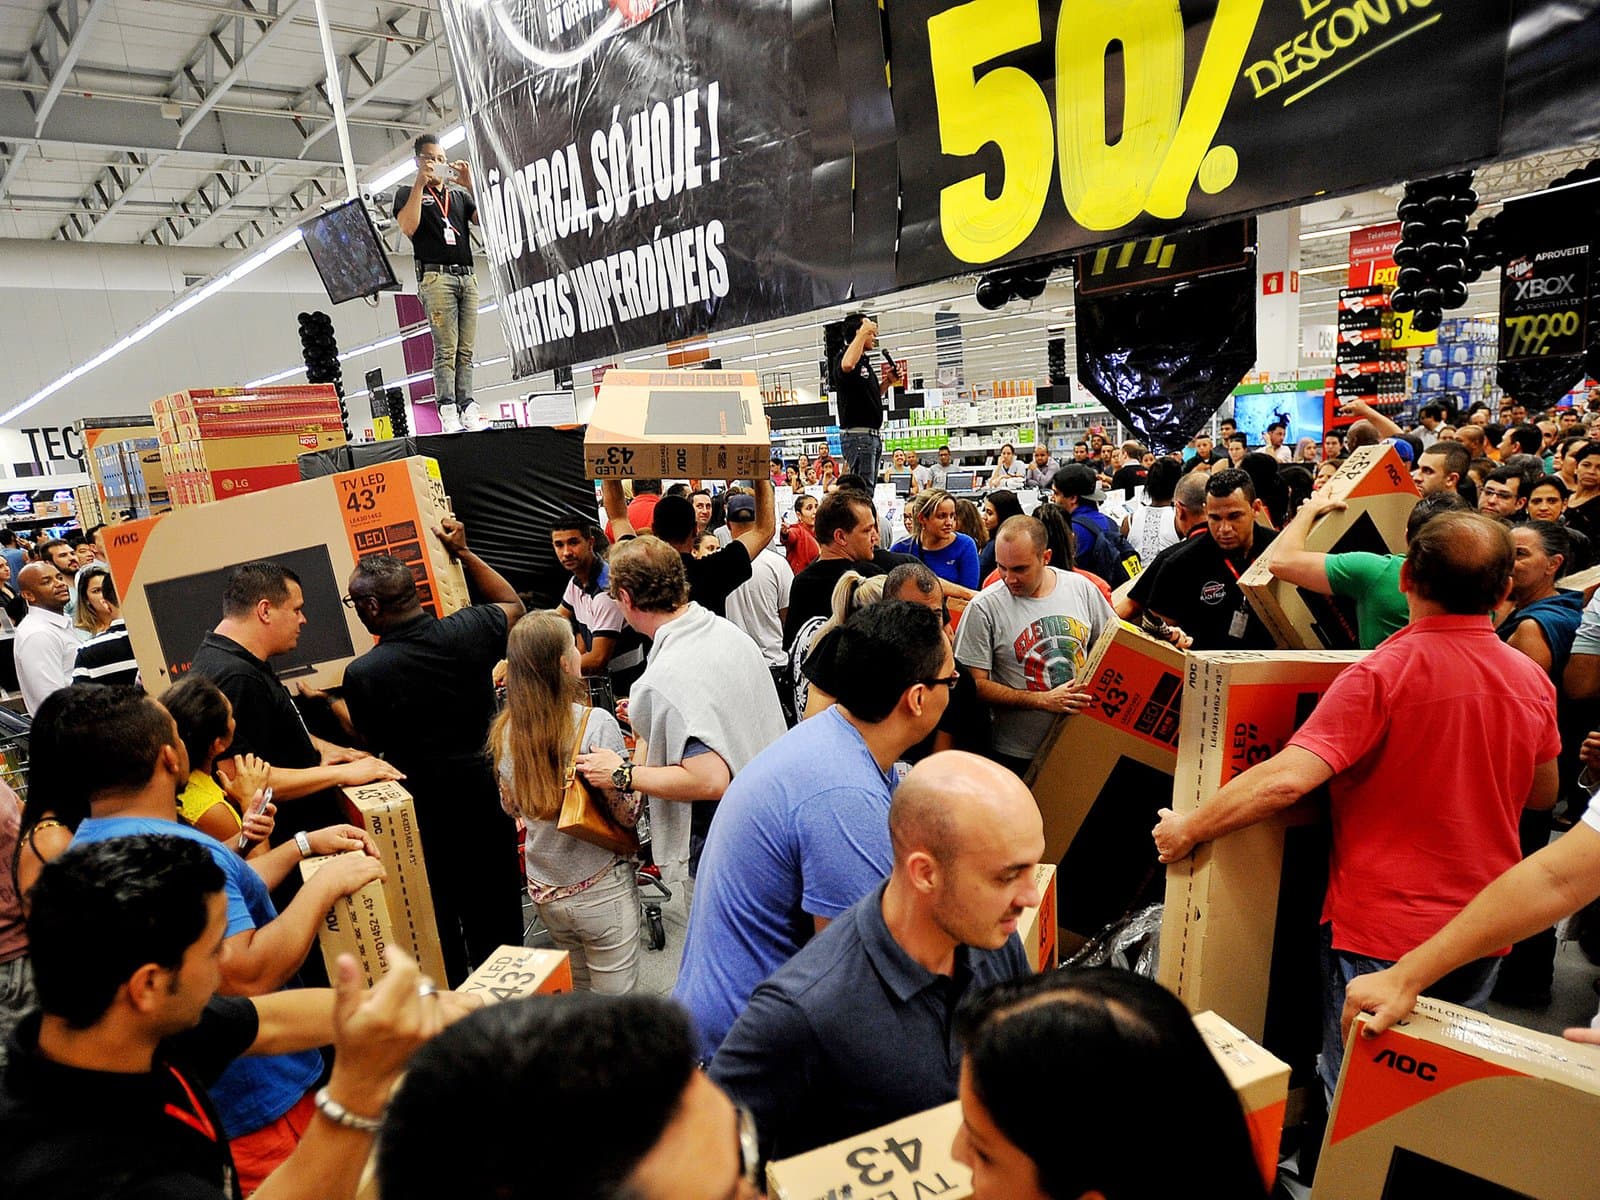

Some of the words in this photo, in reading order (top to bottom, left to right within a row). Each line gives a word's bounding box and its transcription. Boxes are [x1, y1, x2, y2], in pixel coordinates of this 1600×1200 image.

[517, 142, 594, 254] PERCA,
[591, 104, 630, 223] SÓ
[631, 88, 703, 209] HOJE
[1535, 244, 1589, 262] APROVEITE!
[569, 219, 730, 333] IMPERDÍVEIS
[1514, 274, 1576, 301] XBOX
[1274, 382, 1298, 392] XBOX
[595, 464, 617, 475] LED
[619, 465, 635, 475] TV
[235, 478, 249, 489] LG
[340, 476, 358, 492] TV
[361, 472, 385, 487] LED
[356, 531, 384, 549] LED
[1097, 668, 1115, 693] LED
[1232, 722, 1247, 760] LED
[481, 956, 513, 979] LED
[1372, 1049, 1439, 1082] AOC
